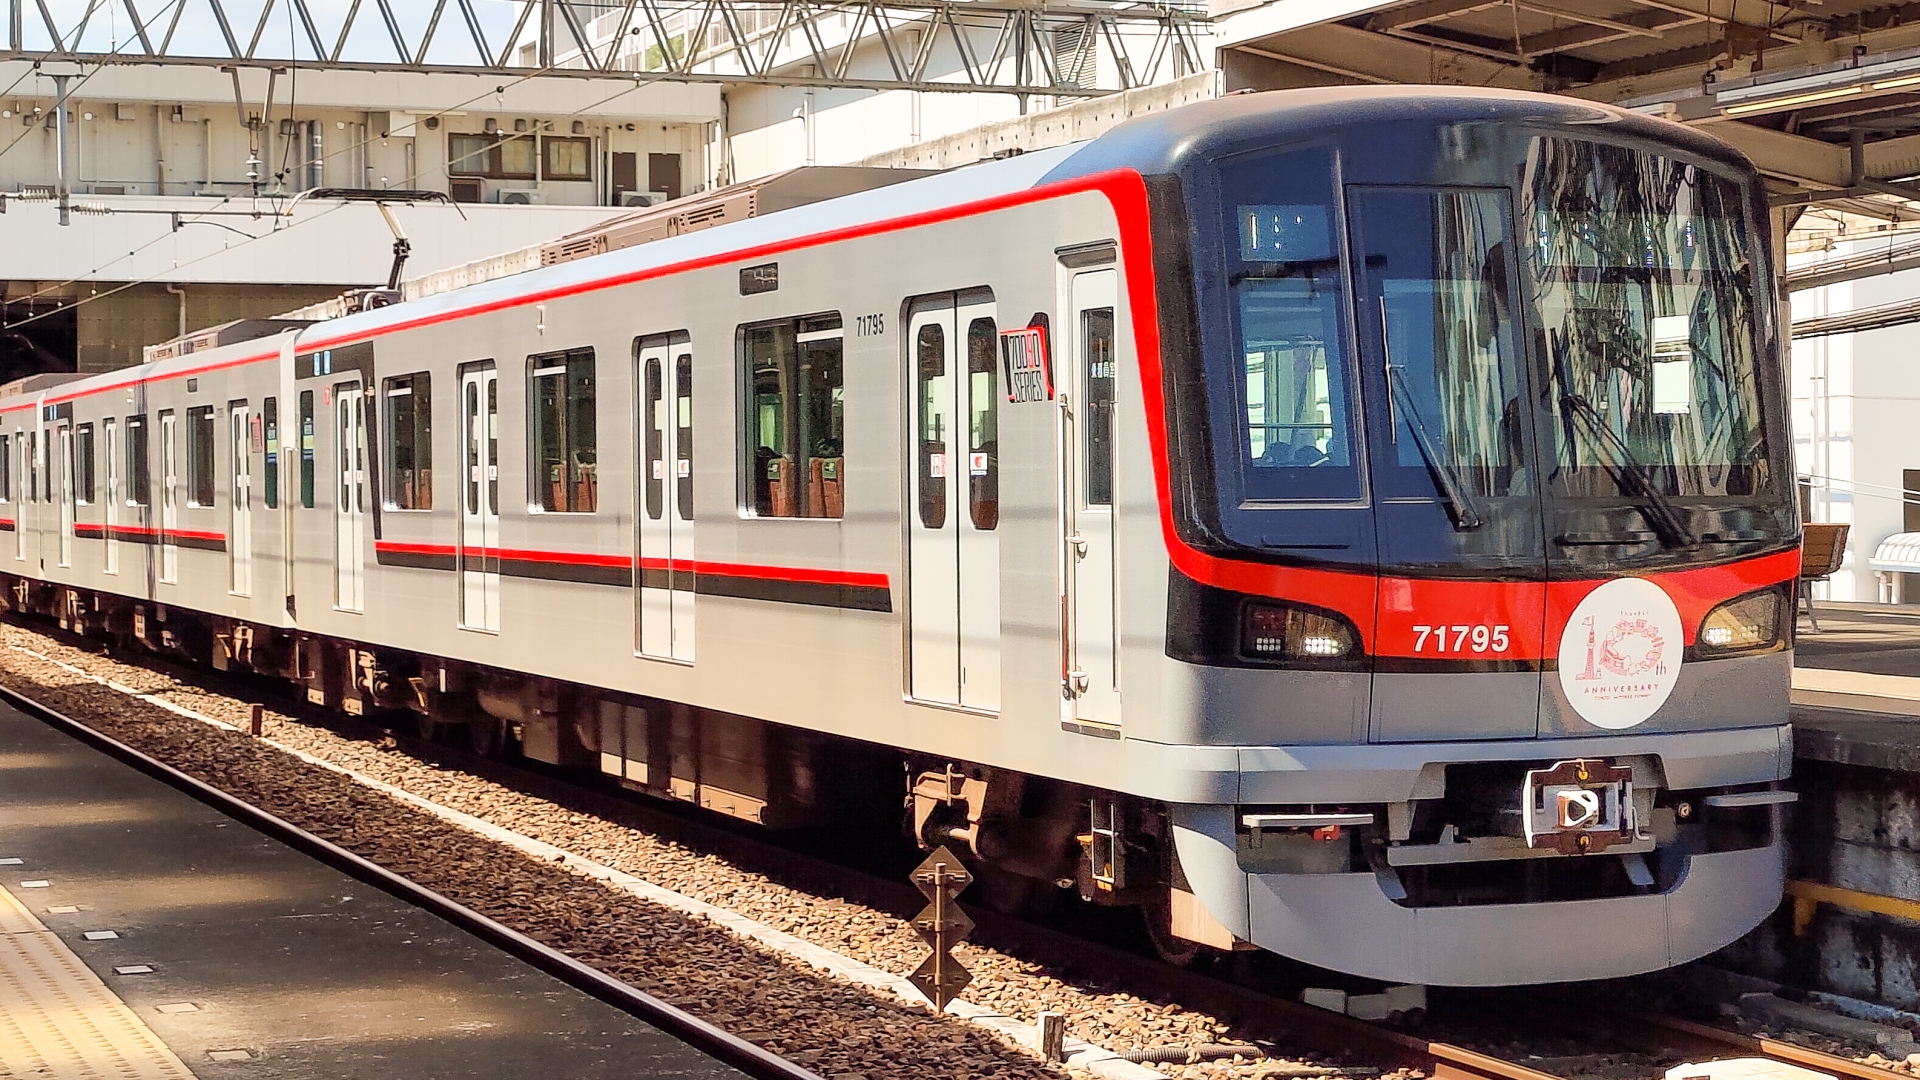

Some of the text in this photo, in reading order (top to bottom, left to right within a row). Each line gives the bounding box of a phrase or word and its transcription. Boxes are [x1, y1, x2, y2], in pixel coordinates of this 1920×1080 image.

[856, 313, 884, 337] 71795
[1014, 370, 1043, 402] SERIES
[1412, 625, 1510, 652] 71795
[1584, 683, 1659, 694] ANNIVERSARY
